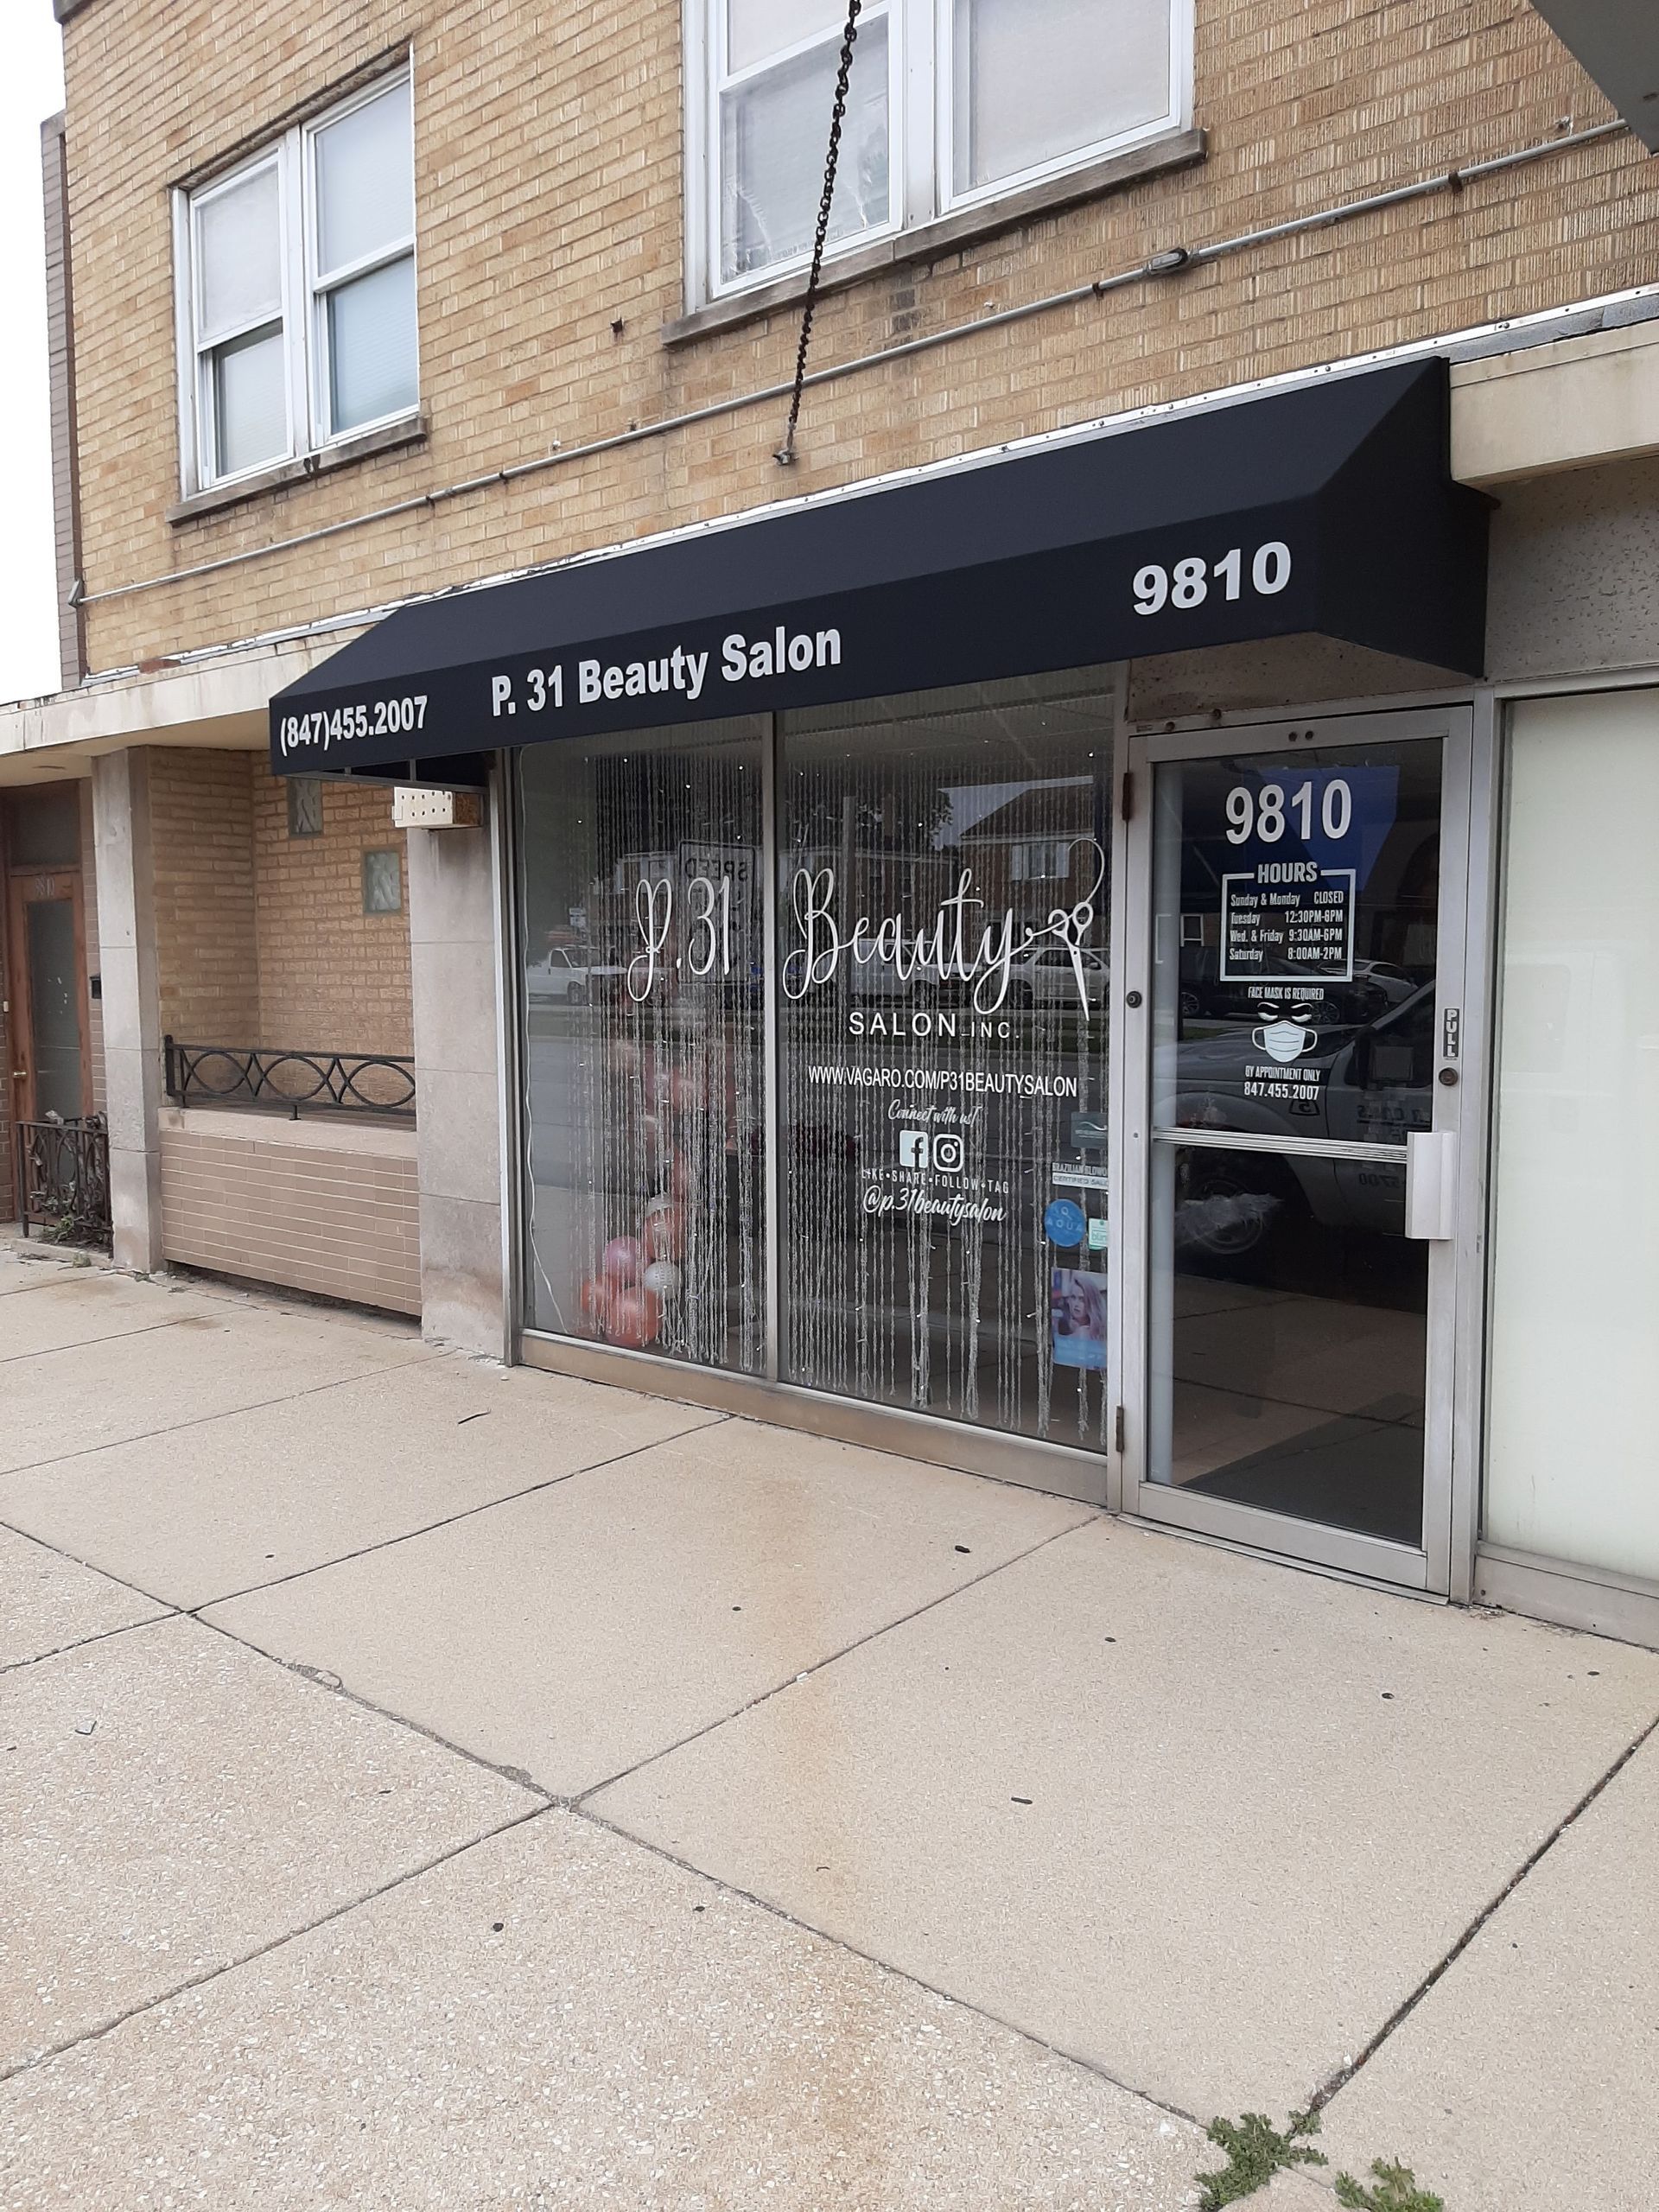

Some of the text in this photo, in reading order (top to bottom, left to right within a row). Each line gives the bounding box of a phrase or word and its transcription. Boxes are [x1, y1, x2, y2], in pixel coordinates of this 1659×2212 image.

[1133, 541, 1292, 615] 9810
[492, 628, 841, 717] P. 31 Beauty Salon
[279, 695, 428, 757] (847)455.2007
[1226, 779, 1351, 845] 9810
[1257, 861, 1318, 883] HOURS
[1230, 891, 1344, 908] Sunday & Monday CLOSED
[1230, 912, 1260, 926] Tuesday
[782, 867, 1028, 1015] Beauty
[1230, 928, 1343, 944] Wed. & Friday 9:30AM-6PM
[1230, 947, 1342, 963] Saturday 8:00AM-2PM
[1248, 987, 1324, 1001] FACE MASK IS REQUIRED
[849, 1011, 1020, 1039] SALON INC.
[1446, 1009, 1457, 1057] PULL
[808, 1065, 1077, 1097] WWW.VAGARO.COM/P31BEAUTYSALON
[1245, 1065, 1320, 1082] BY APPOINTMENT ONLY
[1244, 1082, 1319, 1101] 847.455.2007
[887, 1099, 935, 1122] Connect
[933, 1105, 958, 1125] with
[1053, 1175, 1089, 1184] CERTIFIED
[862, 1185, 1008, 1226] @p.31beautysalon
